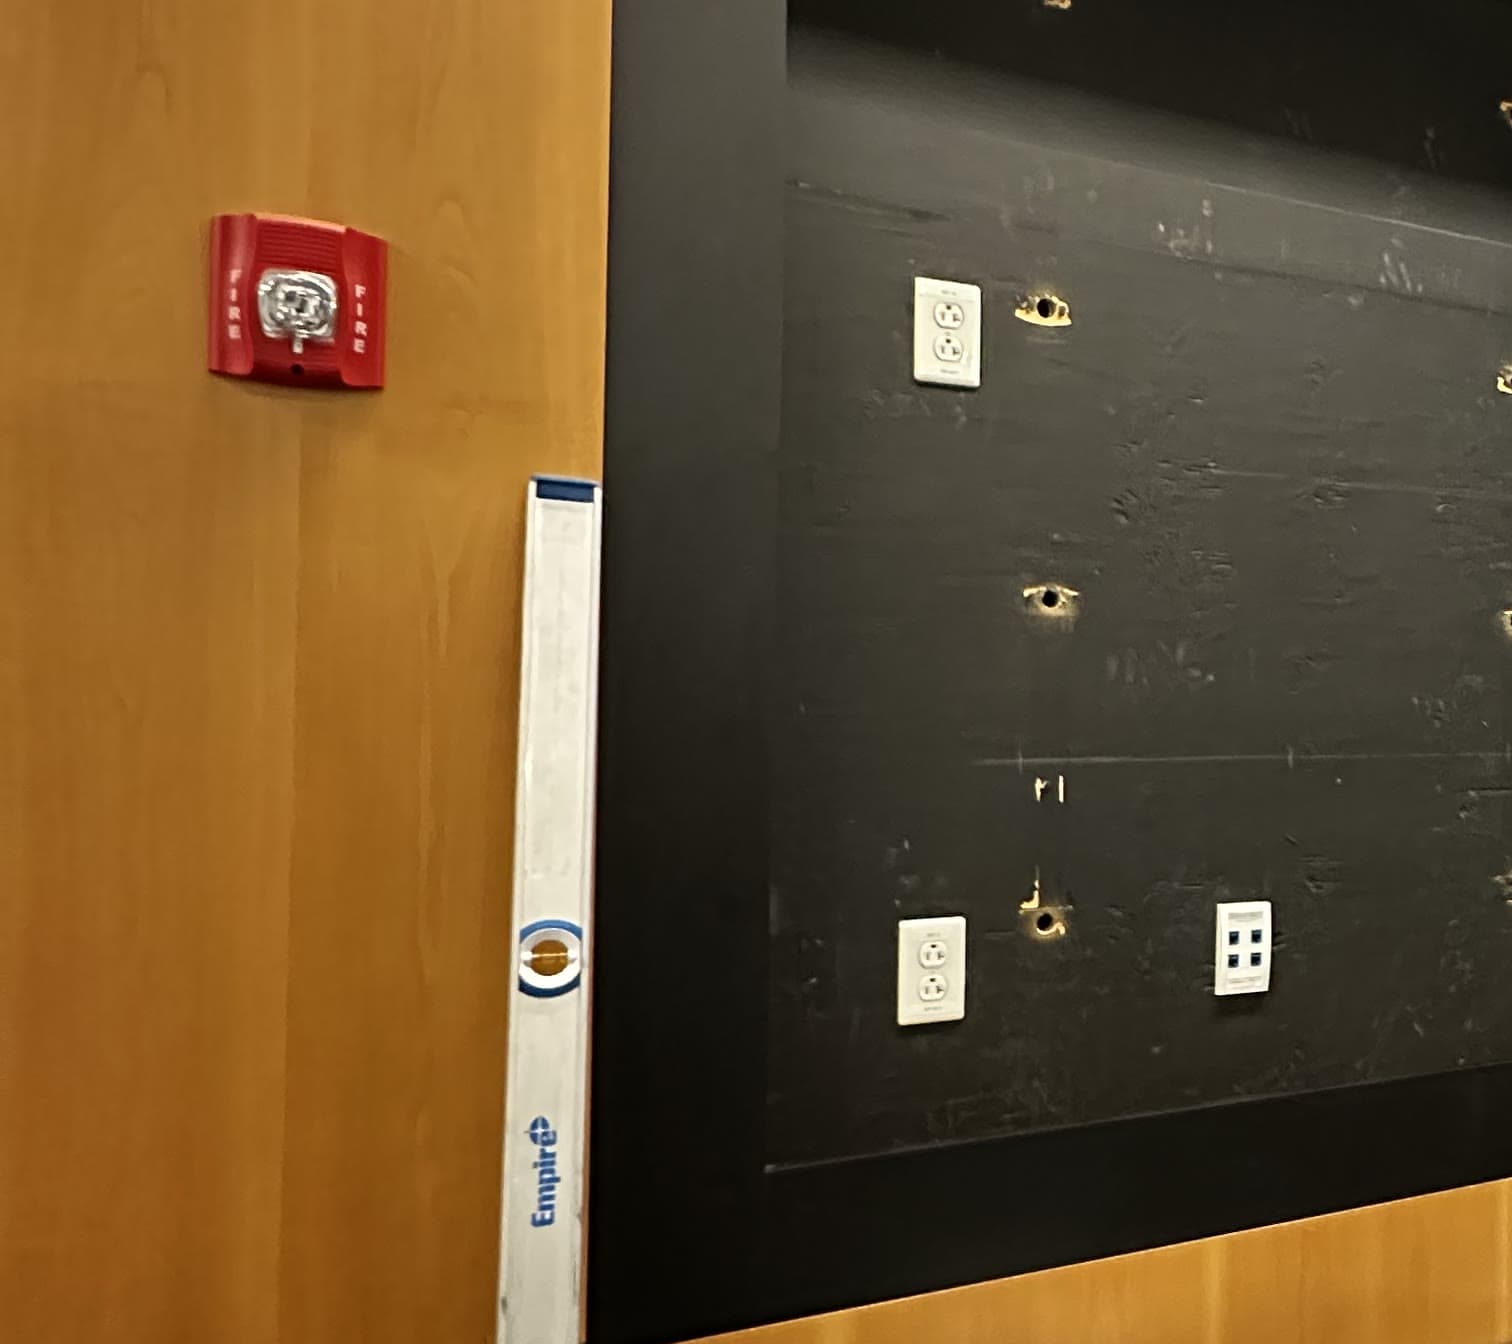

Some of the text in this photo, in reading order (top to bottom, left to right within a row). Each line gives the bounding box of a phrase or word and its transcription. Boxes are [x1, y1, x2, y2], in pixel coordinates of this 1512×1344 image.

[227, 268, 241, 340] FIRE
[353, 284, 368, 354] FIRE
[530, 1125, 561, 1228] Empire
